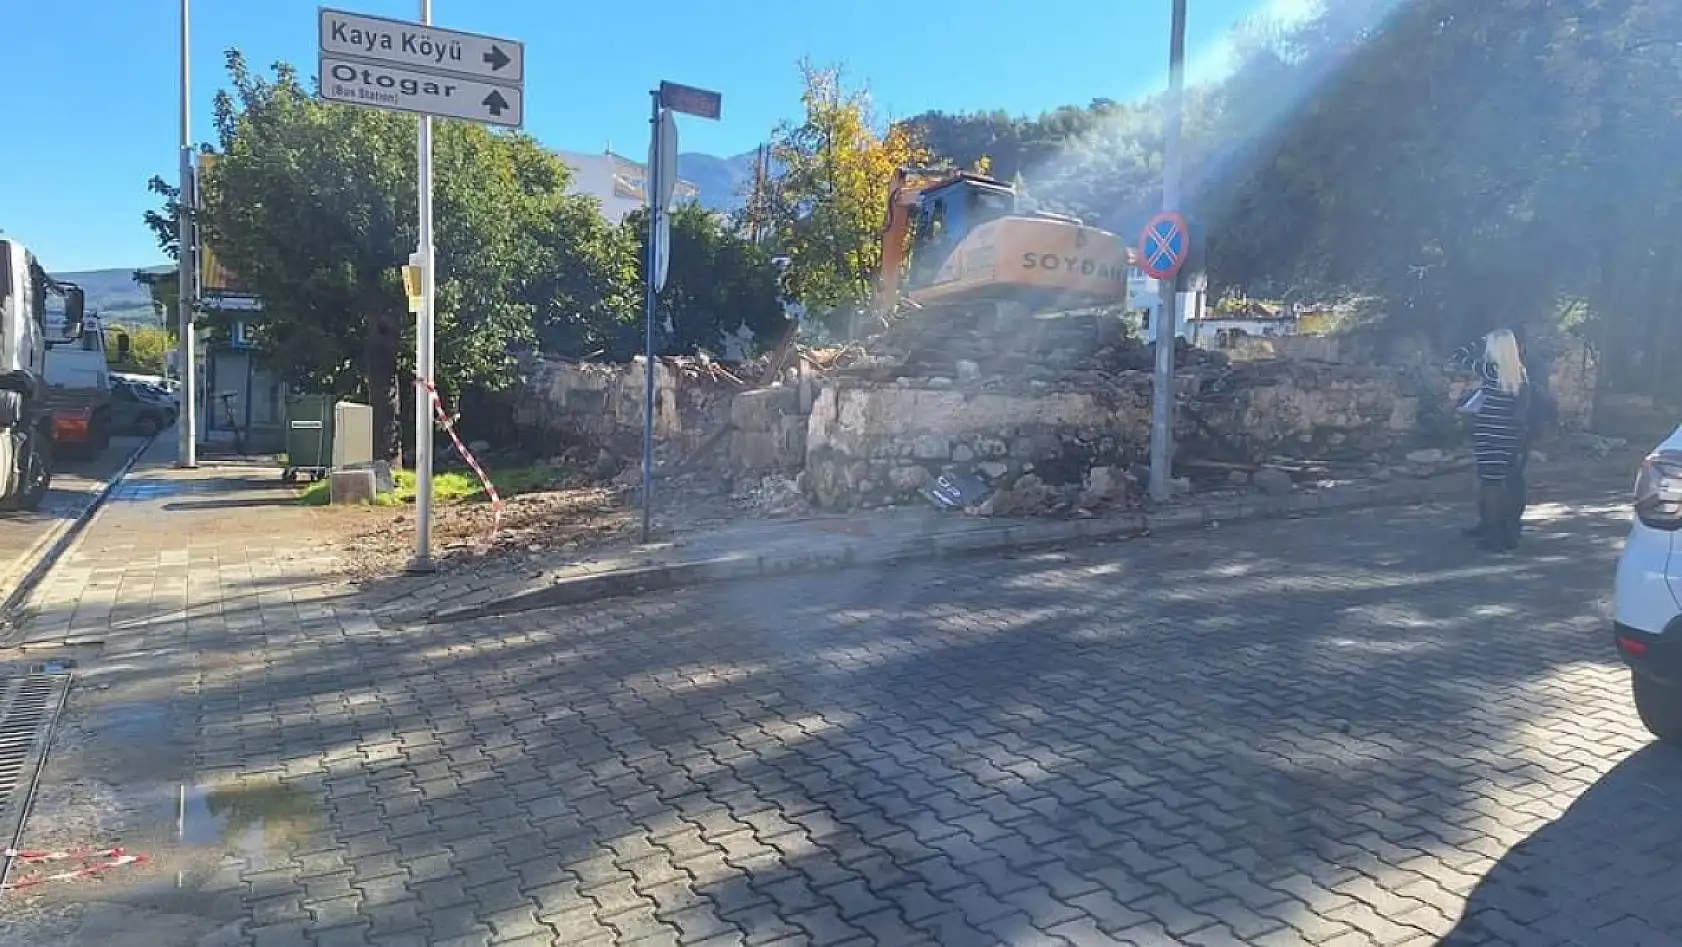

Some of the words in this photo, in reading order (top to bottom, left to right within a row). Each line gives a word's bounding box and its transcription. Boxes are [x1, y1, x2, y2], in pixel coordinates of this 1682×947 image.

[331, 20, 393, 52] Kaya
[401, 31, 462, 62] Köyü
[331, 64, 456, 97] Otogar
